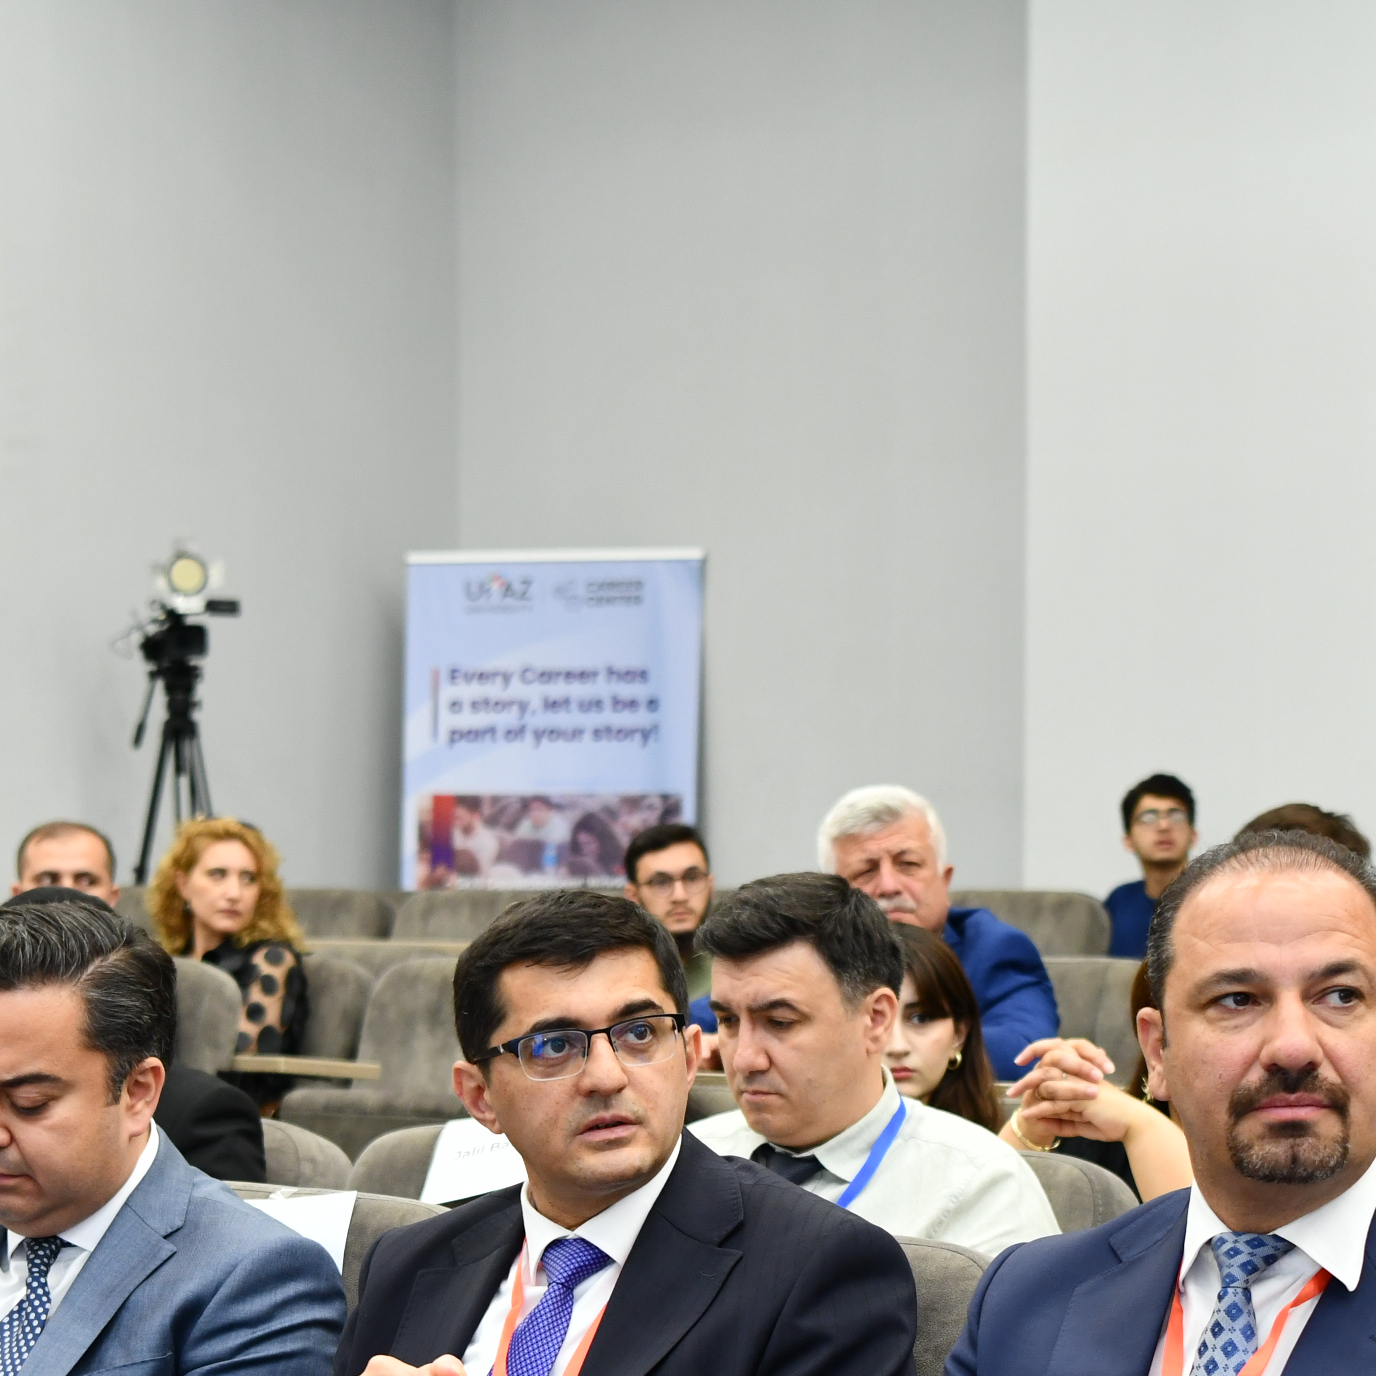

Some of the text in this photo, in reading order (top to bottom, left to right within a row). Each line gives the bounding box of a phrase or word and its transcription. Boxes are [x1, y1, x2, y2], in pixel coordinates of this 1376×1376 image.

[450, 666, 649, 691] Every Career has
[448, 695, 660, 719] a story, let us be a
[448, 724, 659, 749] part of your story!
[453, 1145, 486, 1161] Jalil
